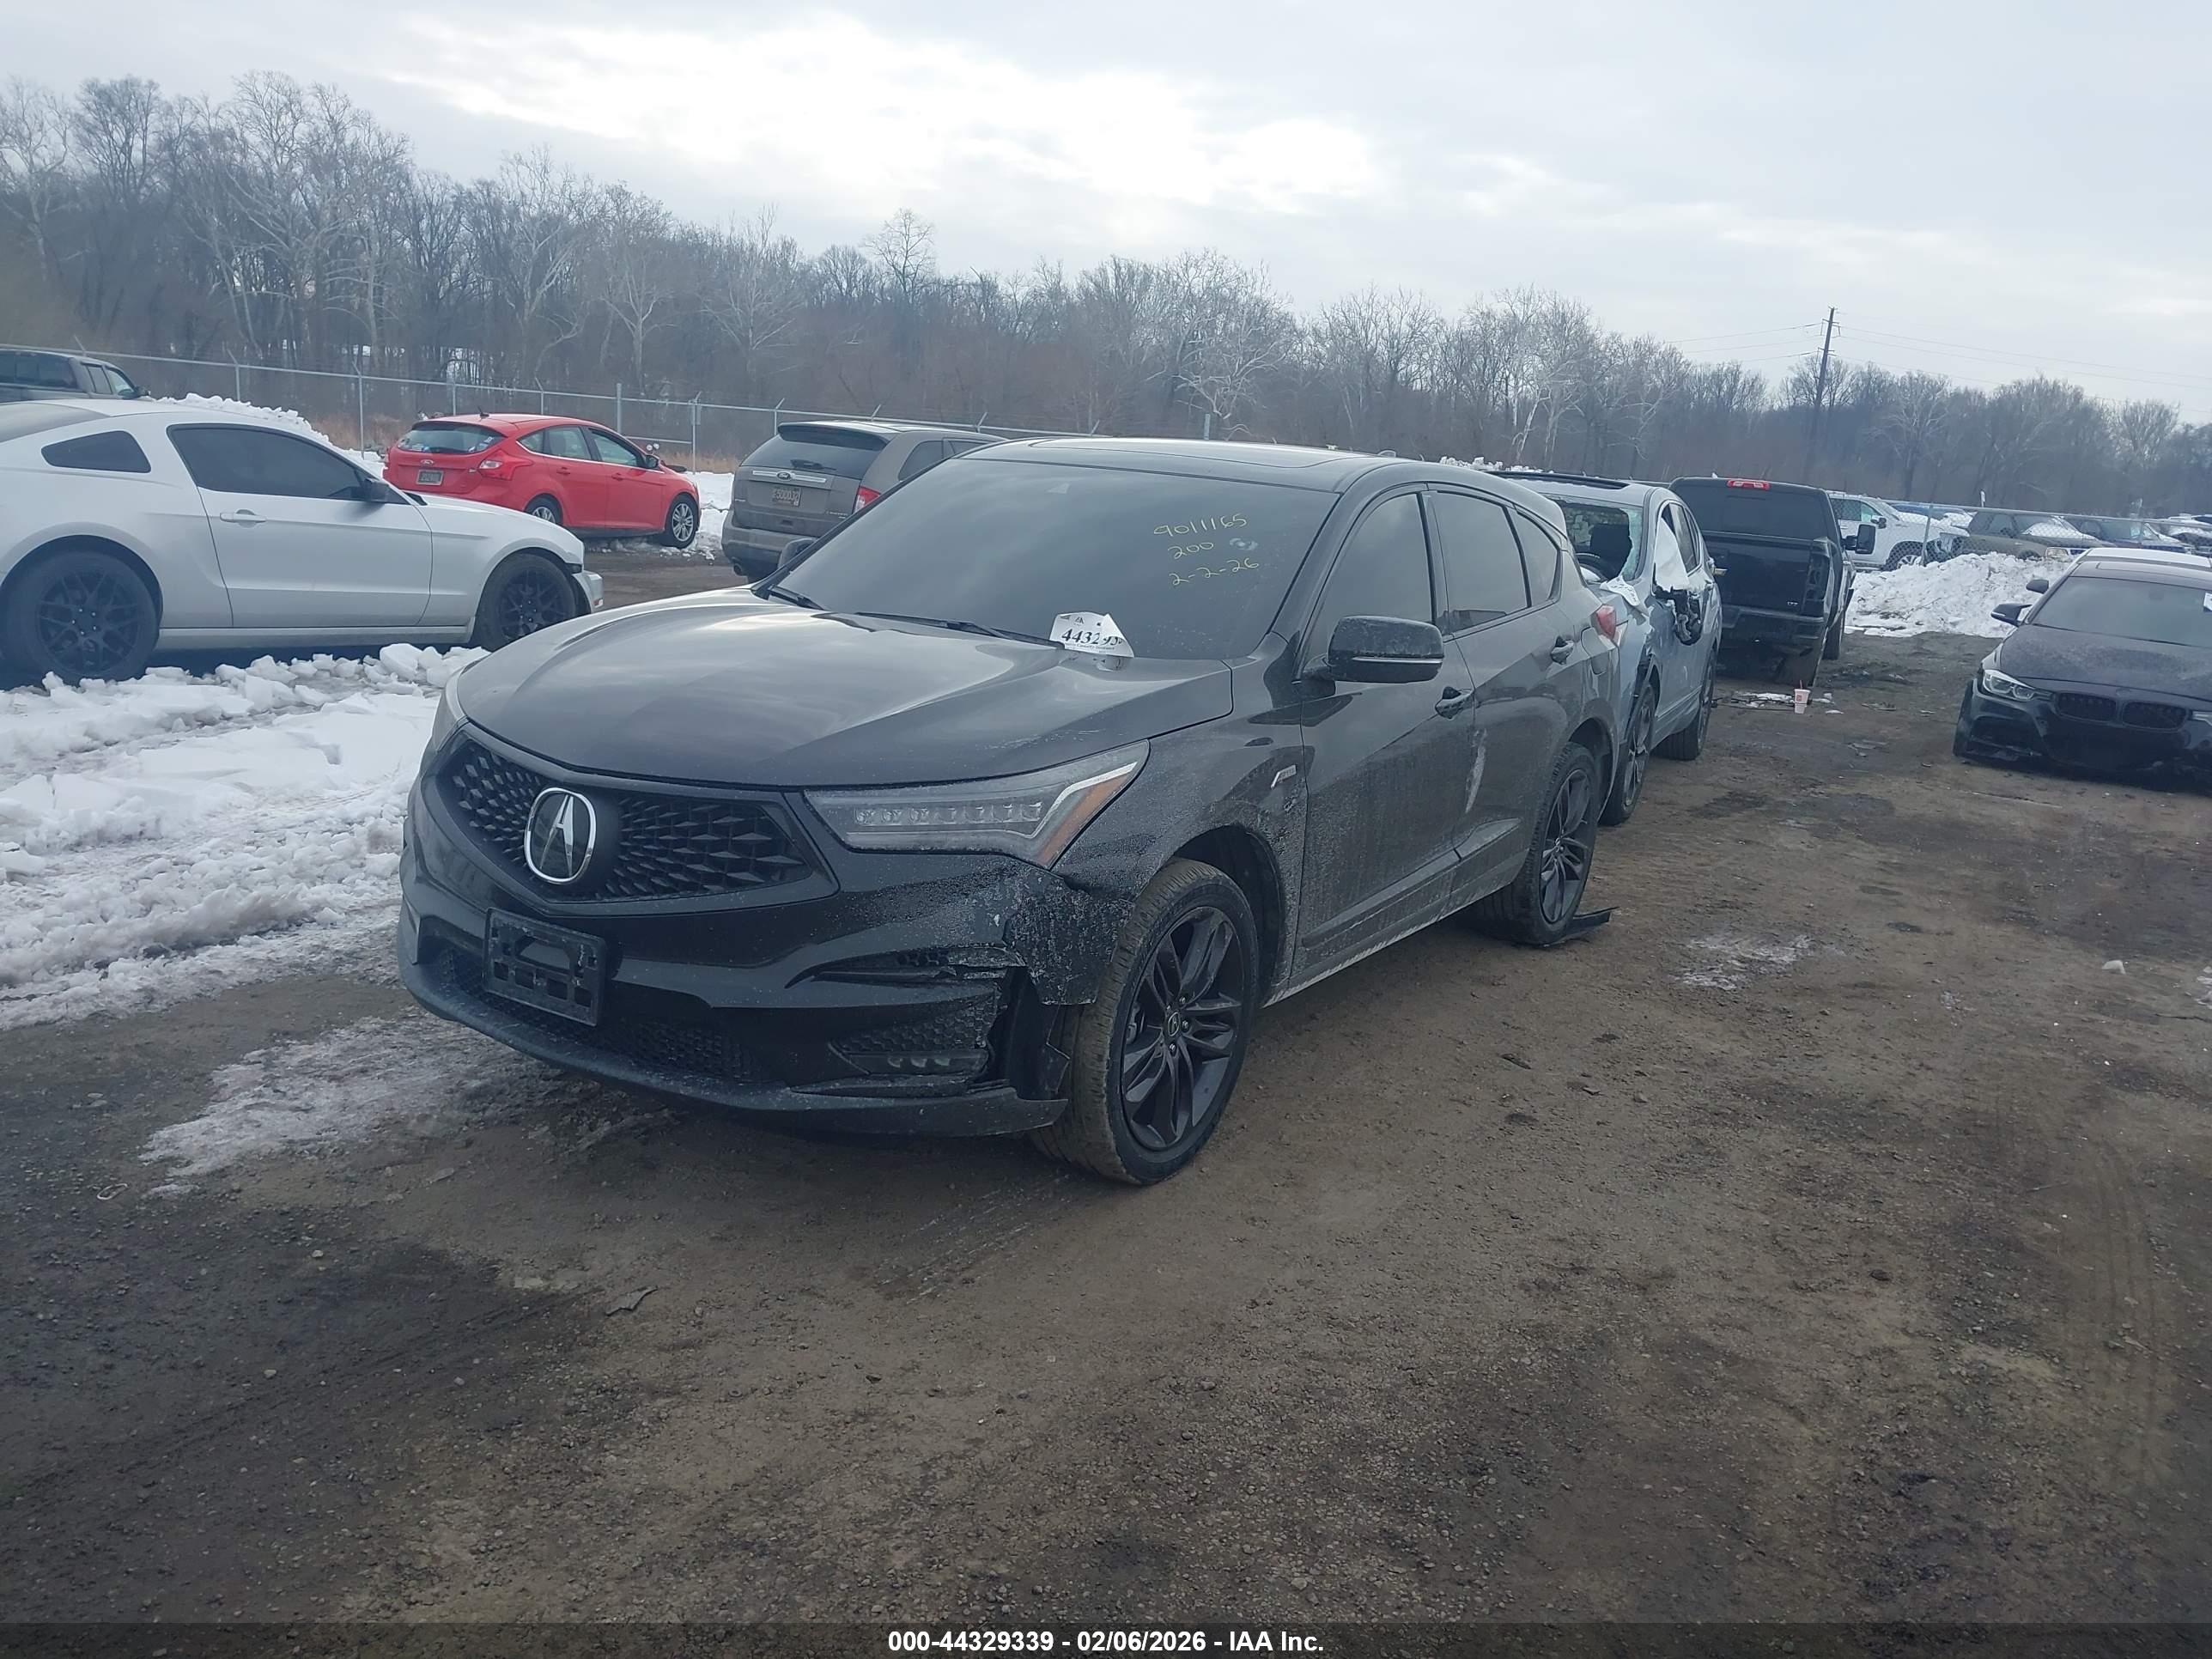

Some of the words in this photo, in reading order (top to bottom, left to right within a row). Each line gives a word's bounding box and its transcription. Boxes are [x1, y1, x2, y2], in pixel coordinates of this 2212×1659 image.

[1153, 514, 1247, 537] 9011165
[1168, 542, 1213, 559] 200
[1169, 557, 1260, 585] 2-2-26
